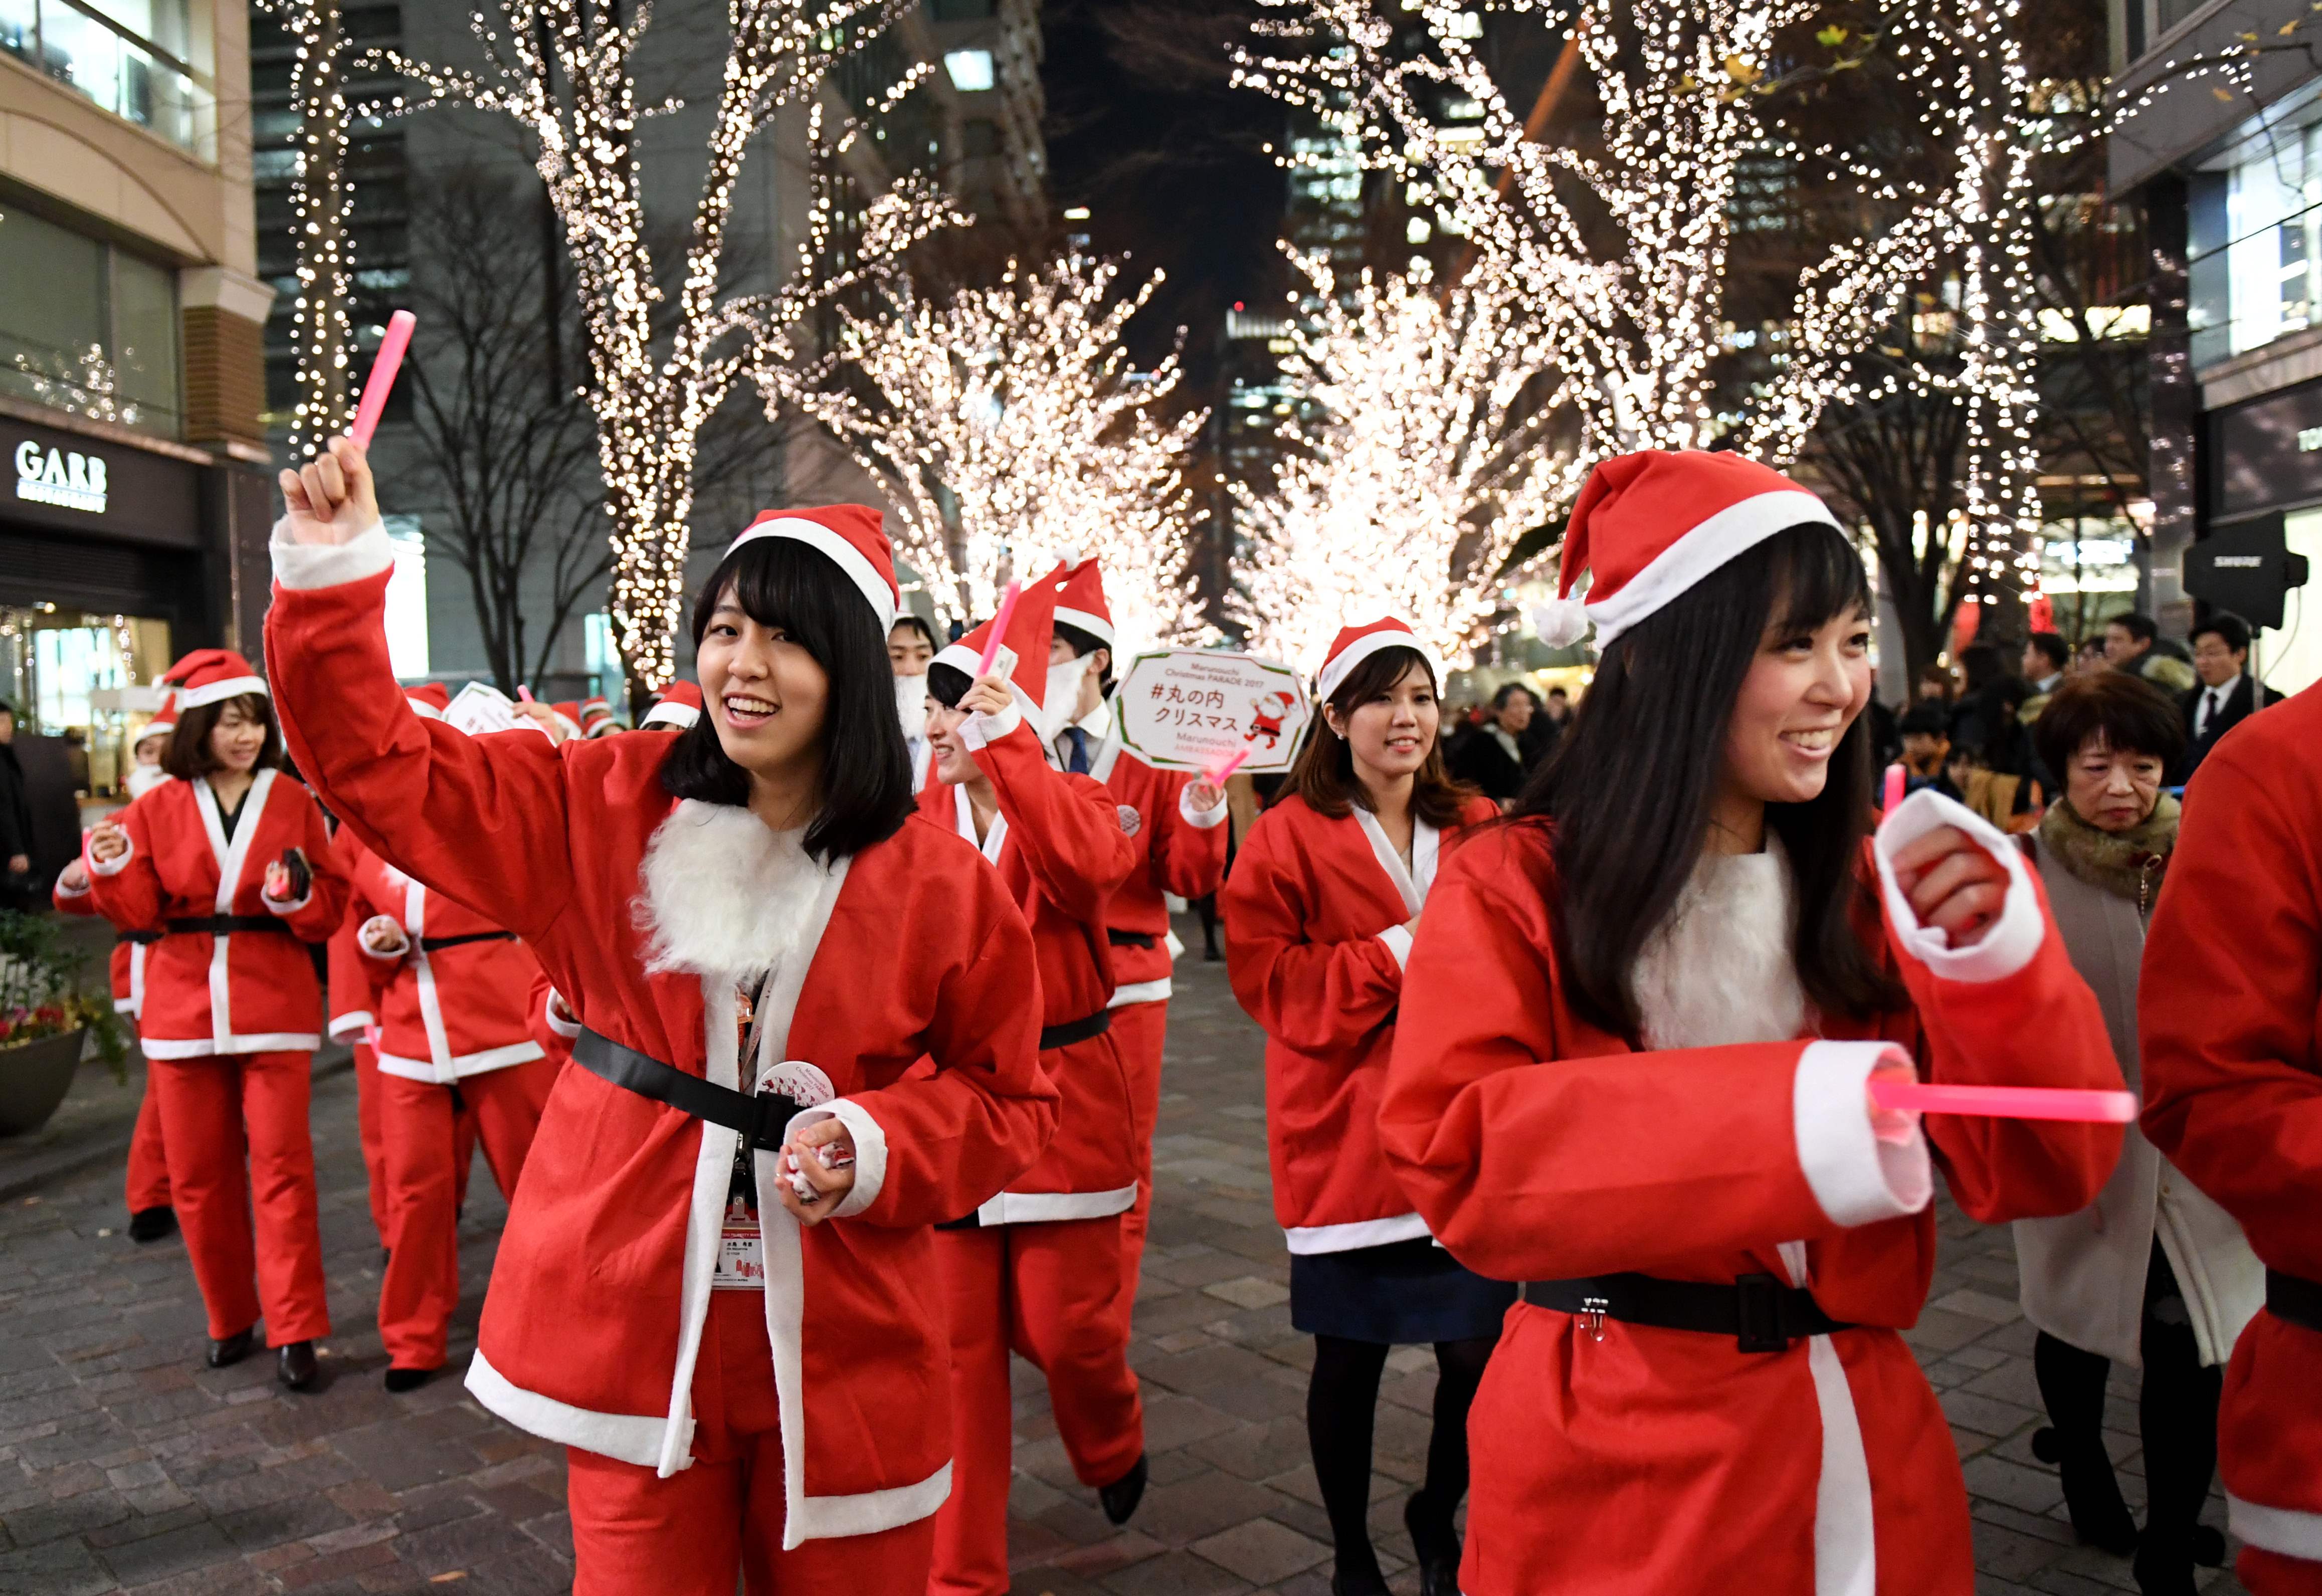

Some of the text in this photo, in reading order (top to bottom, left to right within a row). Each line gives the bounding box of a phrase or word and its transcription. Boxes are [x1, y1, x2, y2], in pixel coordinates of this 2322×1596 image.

[15, 441, 107, 493] GARB
[1166, 668, 1263, 687] Christmas PARADE 2017
[1191, 663, 1239, 675] Marunouchi
[1151, 683, 1224, 709] #丸の内
[1155, 707, 1238, 731] クリスマス
[1177, 732, 1236, 747] Marunouchi
[814, 1083, 829, 1098] PARADE
